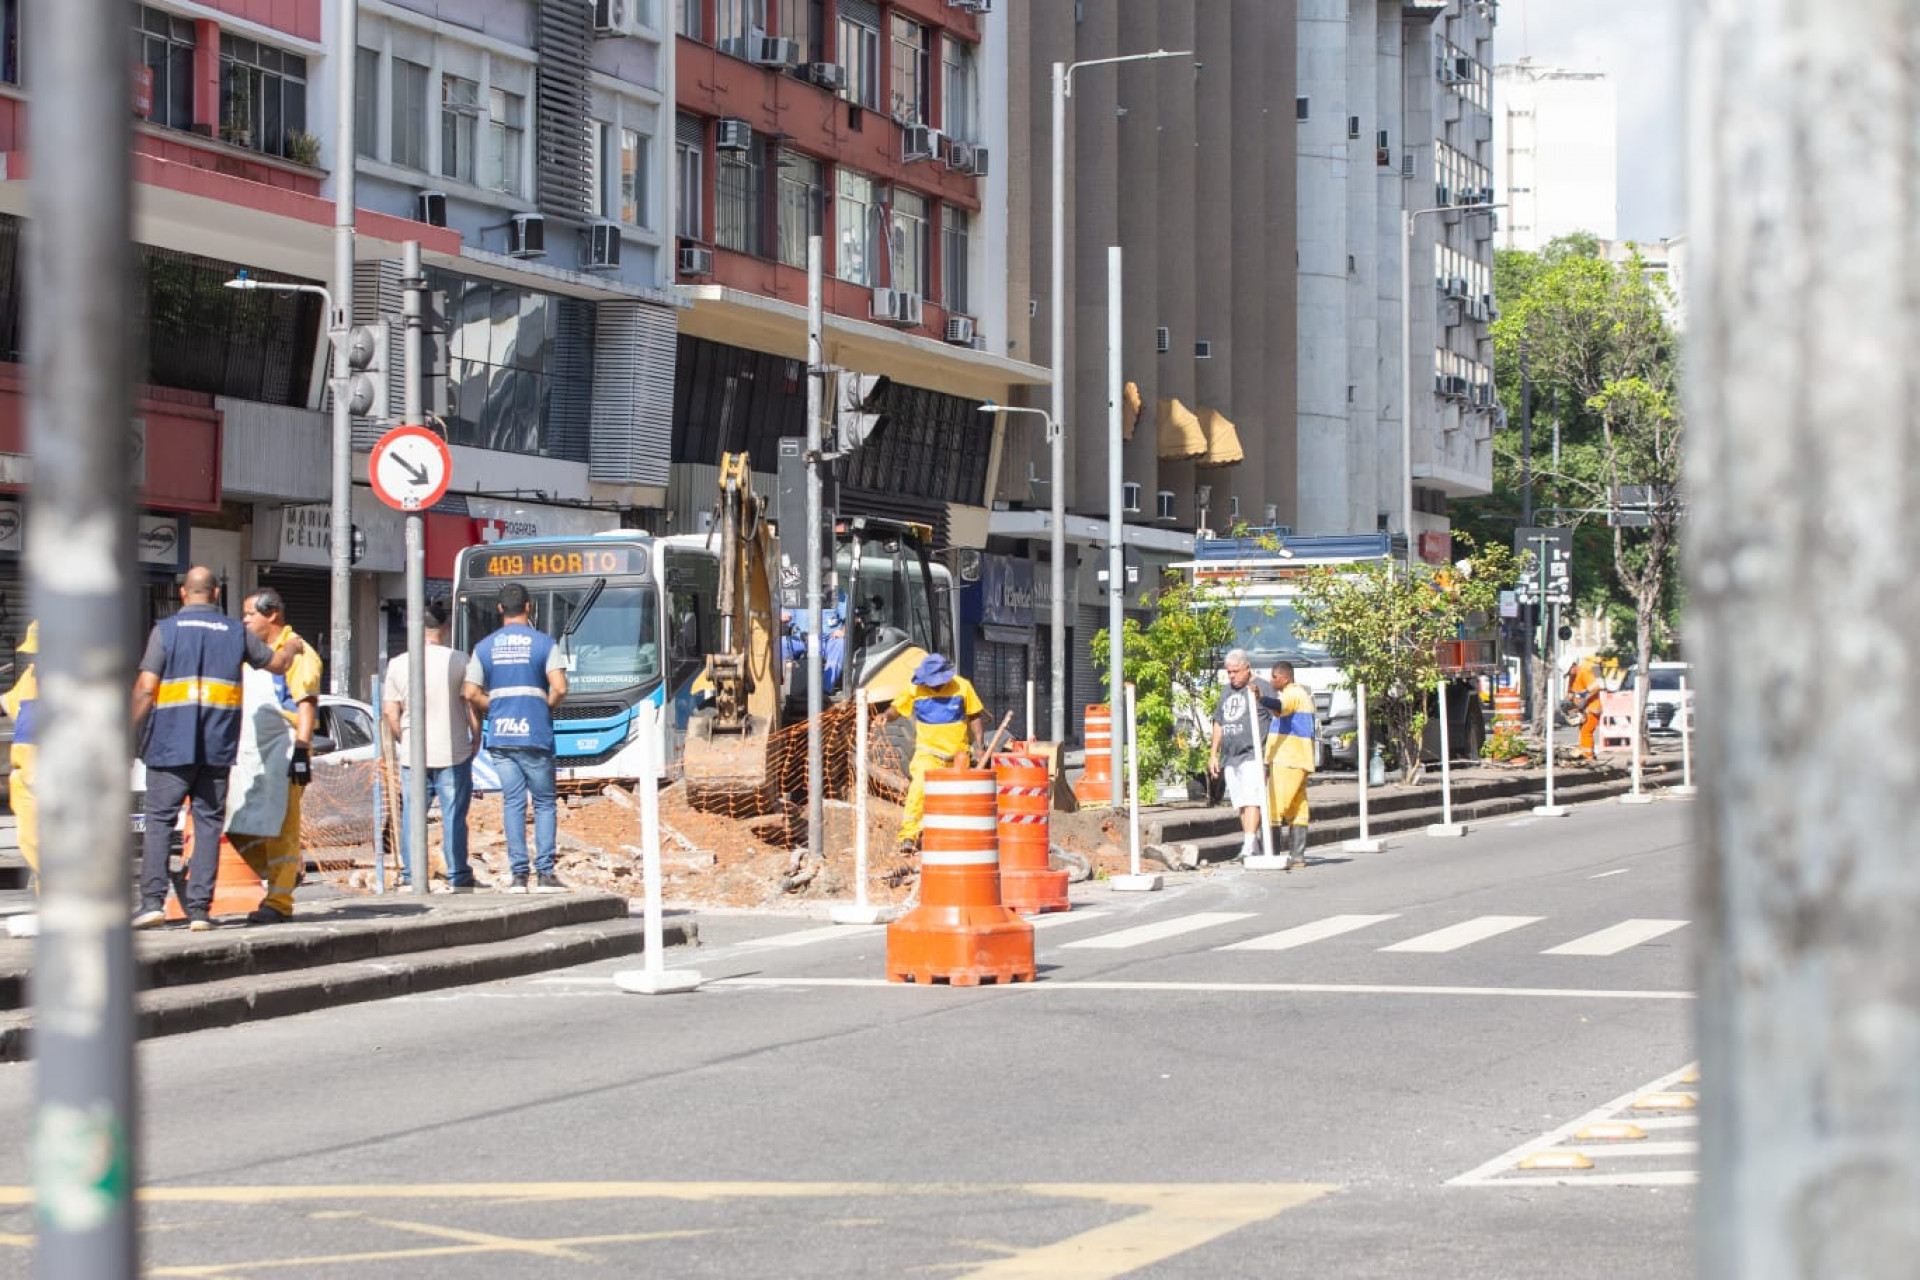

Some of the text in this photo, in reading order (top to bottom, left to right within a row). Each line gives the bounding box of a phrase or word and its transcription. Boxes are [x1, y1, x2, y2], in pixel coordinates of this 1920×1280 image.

[287, 508, 331, 528] MARIA
[504, 521, 537, 538] ROGARIA
[487, 551, 617, 575] 409 HORTO
[495, 718, 530, 734] 1746
